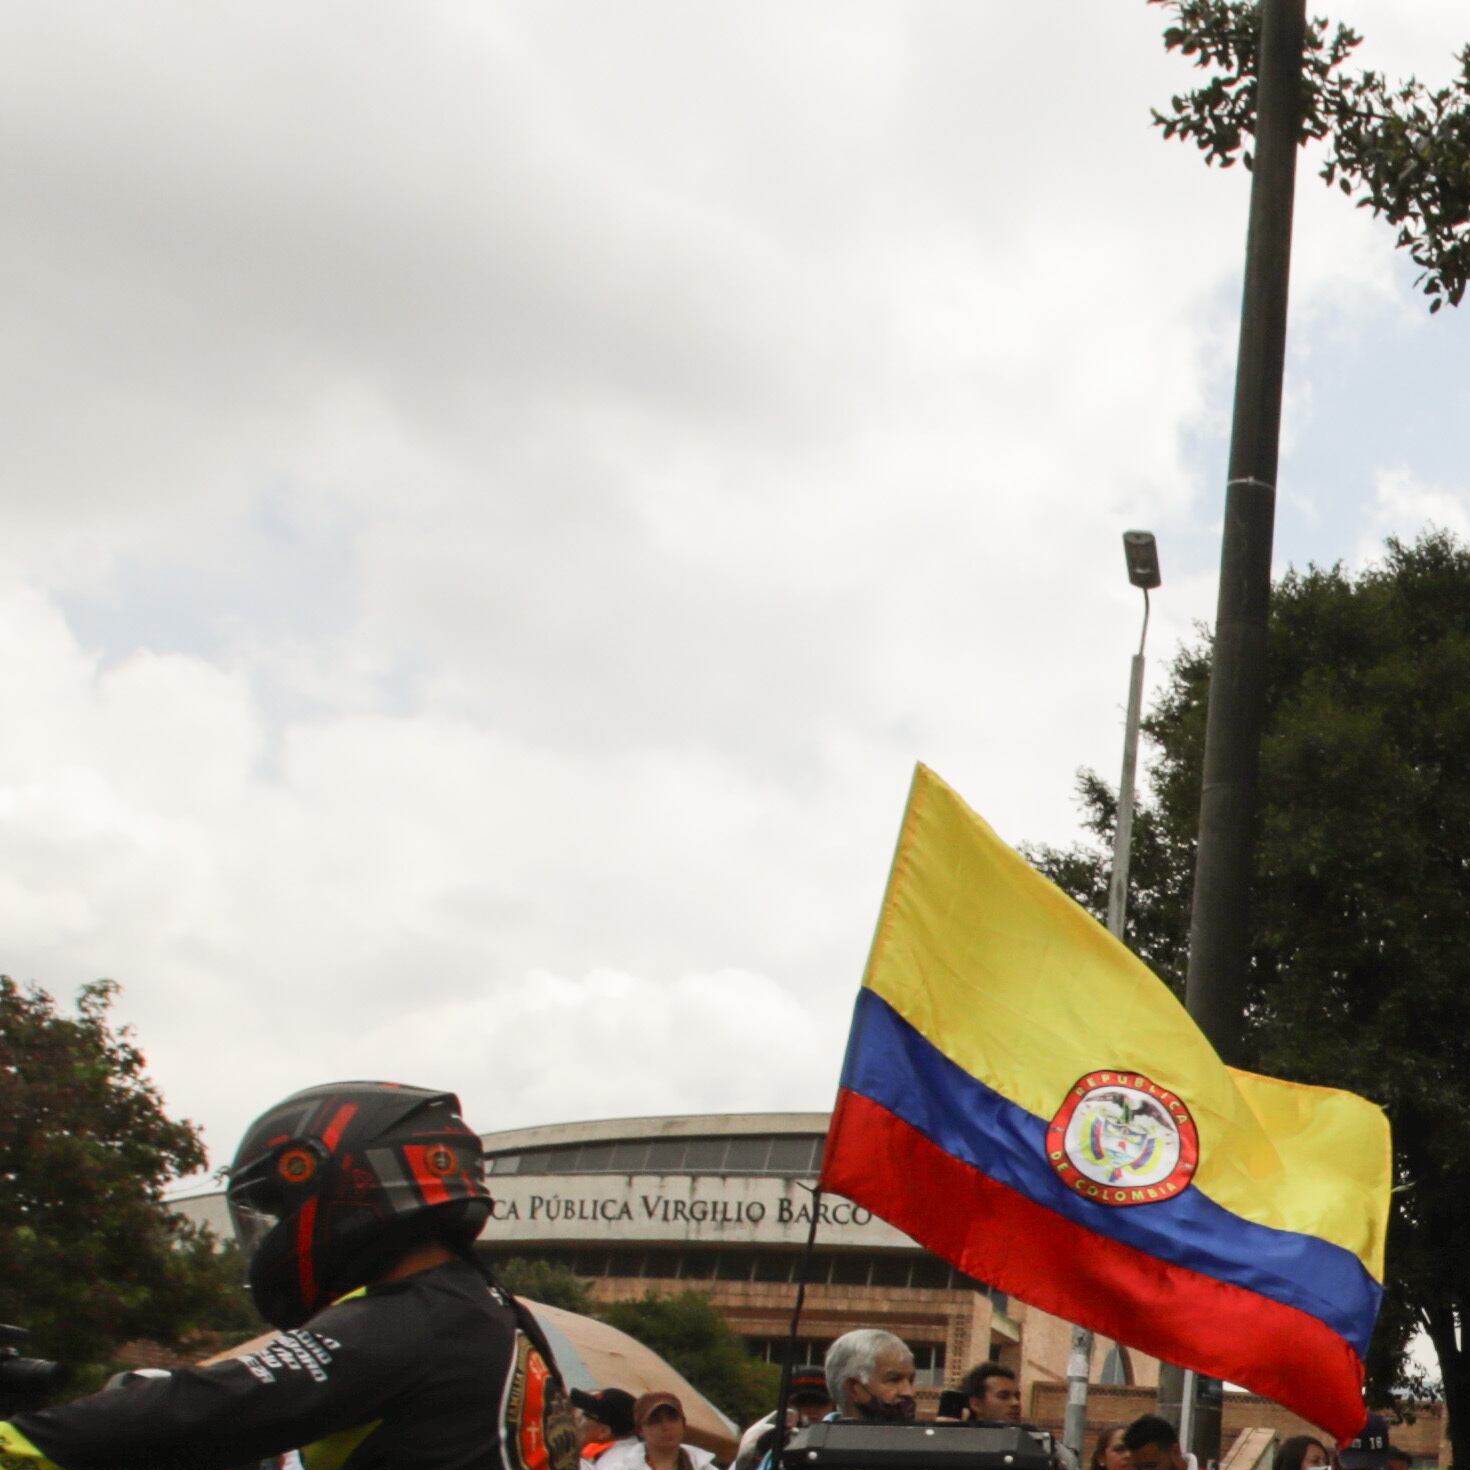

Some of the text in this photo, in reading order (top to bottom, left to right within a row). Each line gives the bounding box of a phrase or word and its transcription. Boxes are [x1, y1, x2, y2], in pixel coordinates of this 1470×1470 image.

[1050, 1151, 1178, 1202] DE COLOMBIA
[490, 1194, 872, 1226] CA PÚBLICA VIRGILIO BARCO
